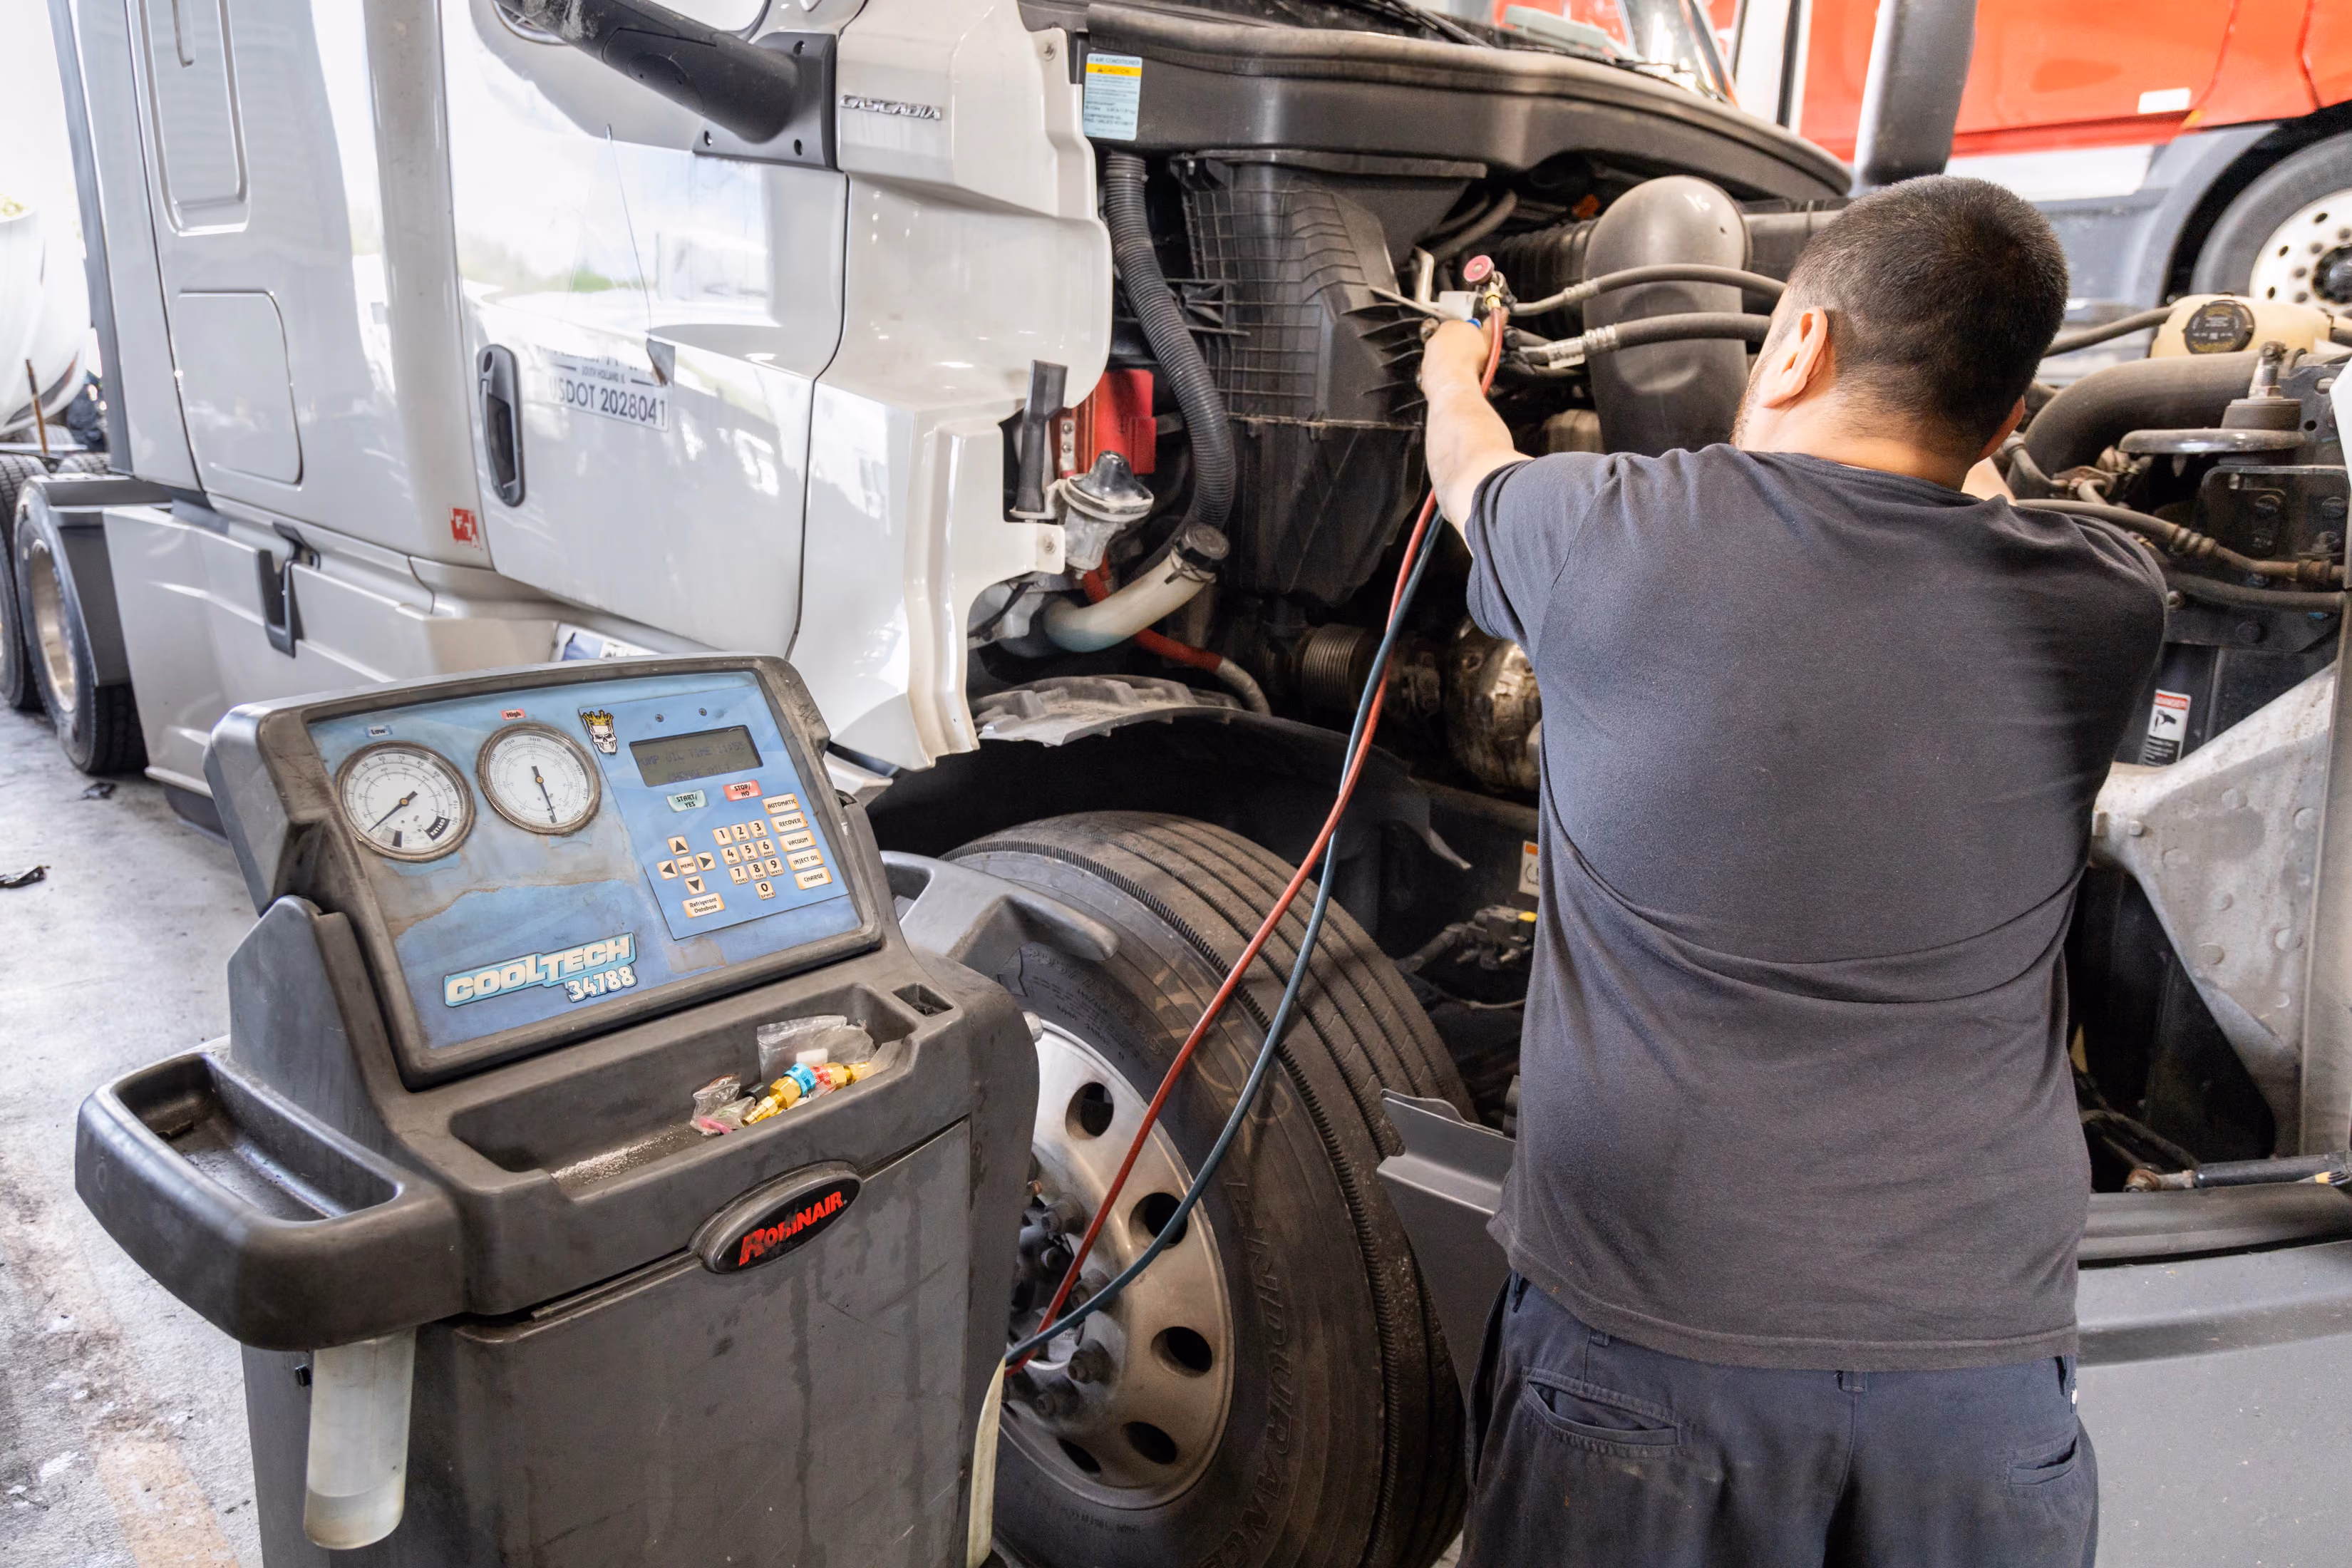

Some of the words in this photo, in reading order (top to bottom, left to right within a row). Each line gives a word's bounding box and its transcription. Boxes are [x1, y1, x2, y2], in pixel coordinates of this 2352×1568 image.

[838, 94, 942, 120] CASCADIA
[549, 375, 595, 409] USDOT
[600, 387, 665, 427] 2028041
[676, 793, 698, 803] START/
[767, 798, 797, 810] AUTOMATIC
[753, 822, 762, 831] 3
[778, 817, 802, 827] RECOVER
[430, 818, 445, 837] RETARD
[736, 826, 744, 835] 2
[718, 830, 726, 839] 1
[763, 841, 770, 850] 6
[787, 836, 809, 847] VACUUM
[727, 849, 734, 858] 4
[744, 845, 752, 854] 5
[770, 860, 778, 869] 9
[793, 856, 810, 866] INJECT
[734, 867, 741, 877] 7
[753, 863, 761, 873] 8
[803, 872, 824, 883] CHARGE
[760, 882, 768, 892] 0
[688, 897, 718, 908] Refrigerant
[693, 904, 718, 914] Database
[446, 935, 631, 1003] COOLTECH
[567, 965, 636, 1001] 34788
